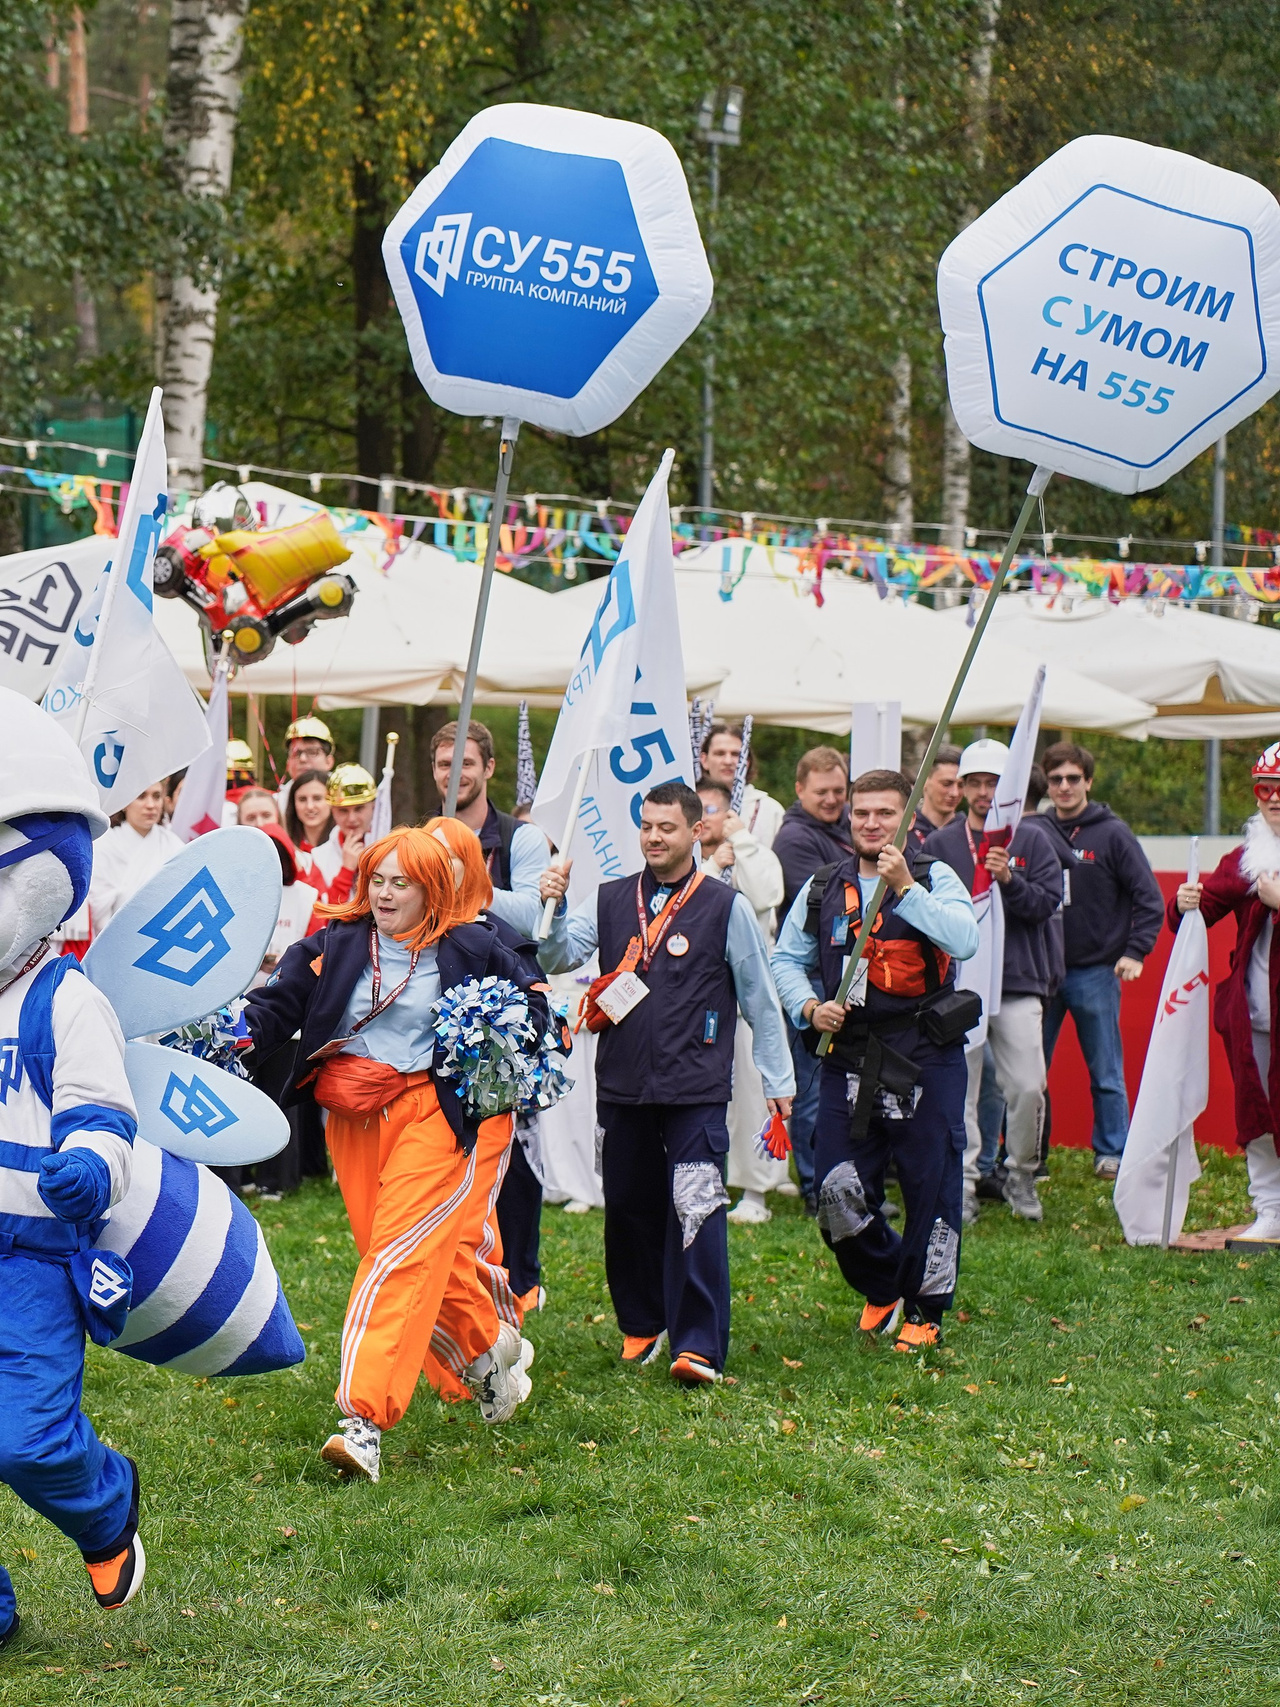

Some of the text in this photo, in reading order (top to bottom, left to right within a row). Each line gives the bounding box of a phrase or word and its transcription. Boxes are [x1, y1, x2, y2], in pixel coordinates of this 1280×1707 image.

[466, 270, 627, 315] ГРУППА КОМПАНИЙ
[472, 226, 636, 295] СУ555
[1058, 243, 1235, 323] СТРОИМ
[1042, 295, 1210, 372] С УМОМ
[1030, 347, 1175, 415] НА 555
[626, 943, 640, 961] 555
